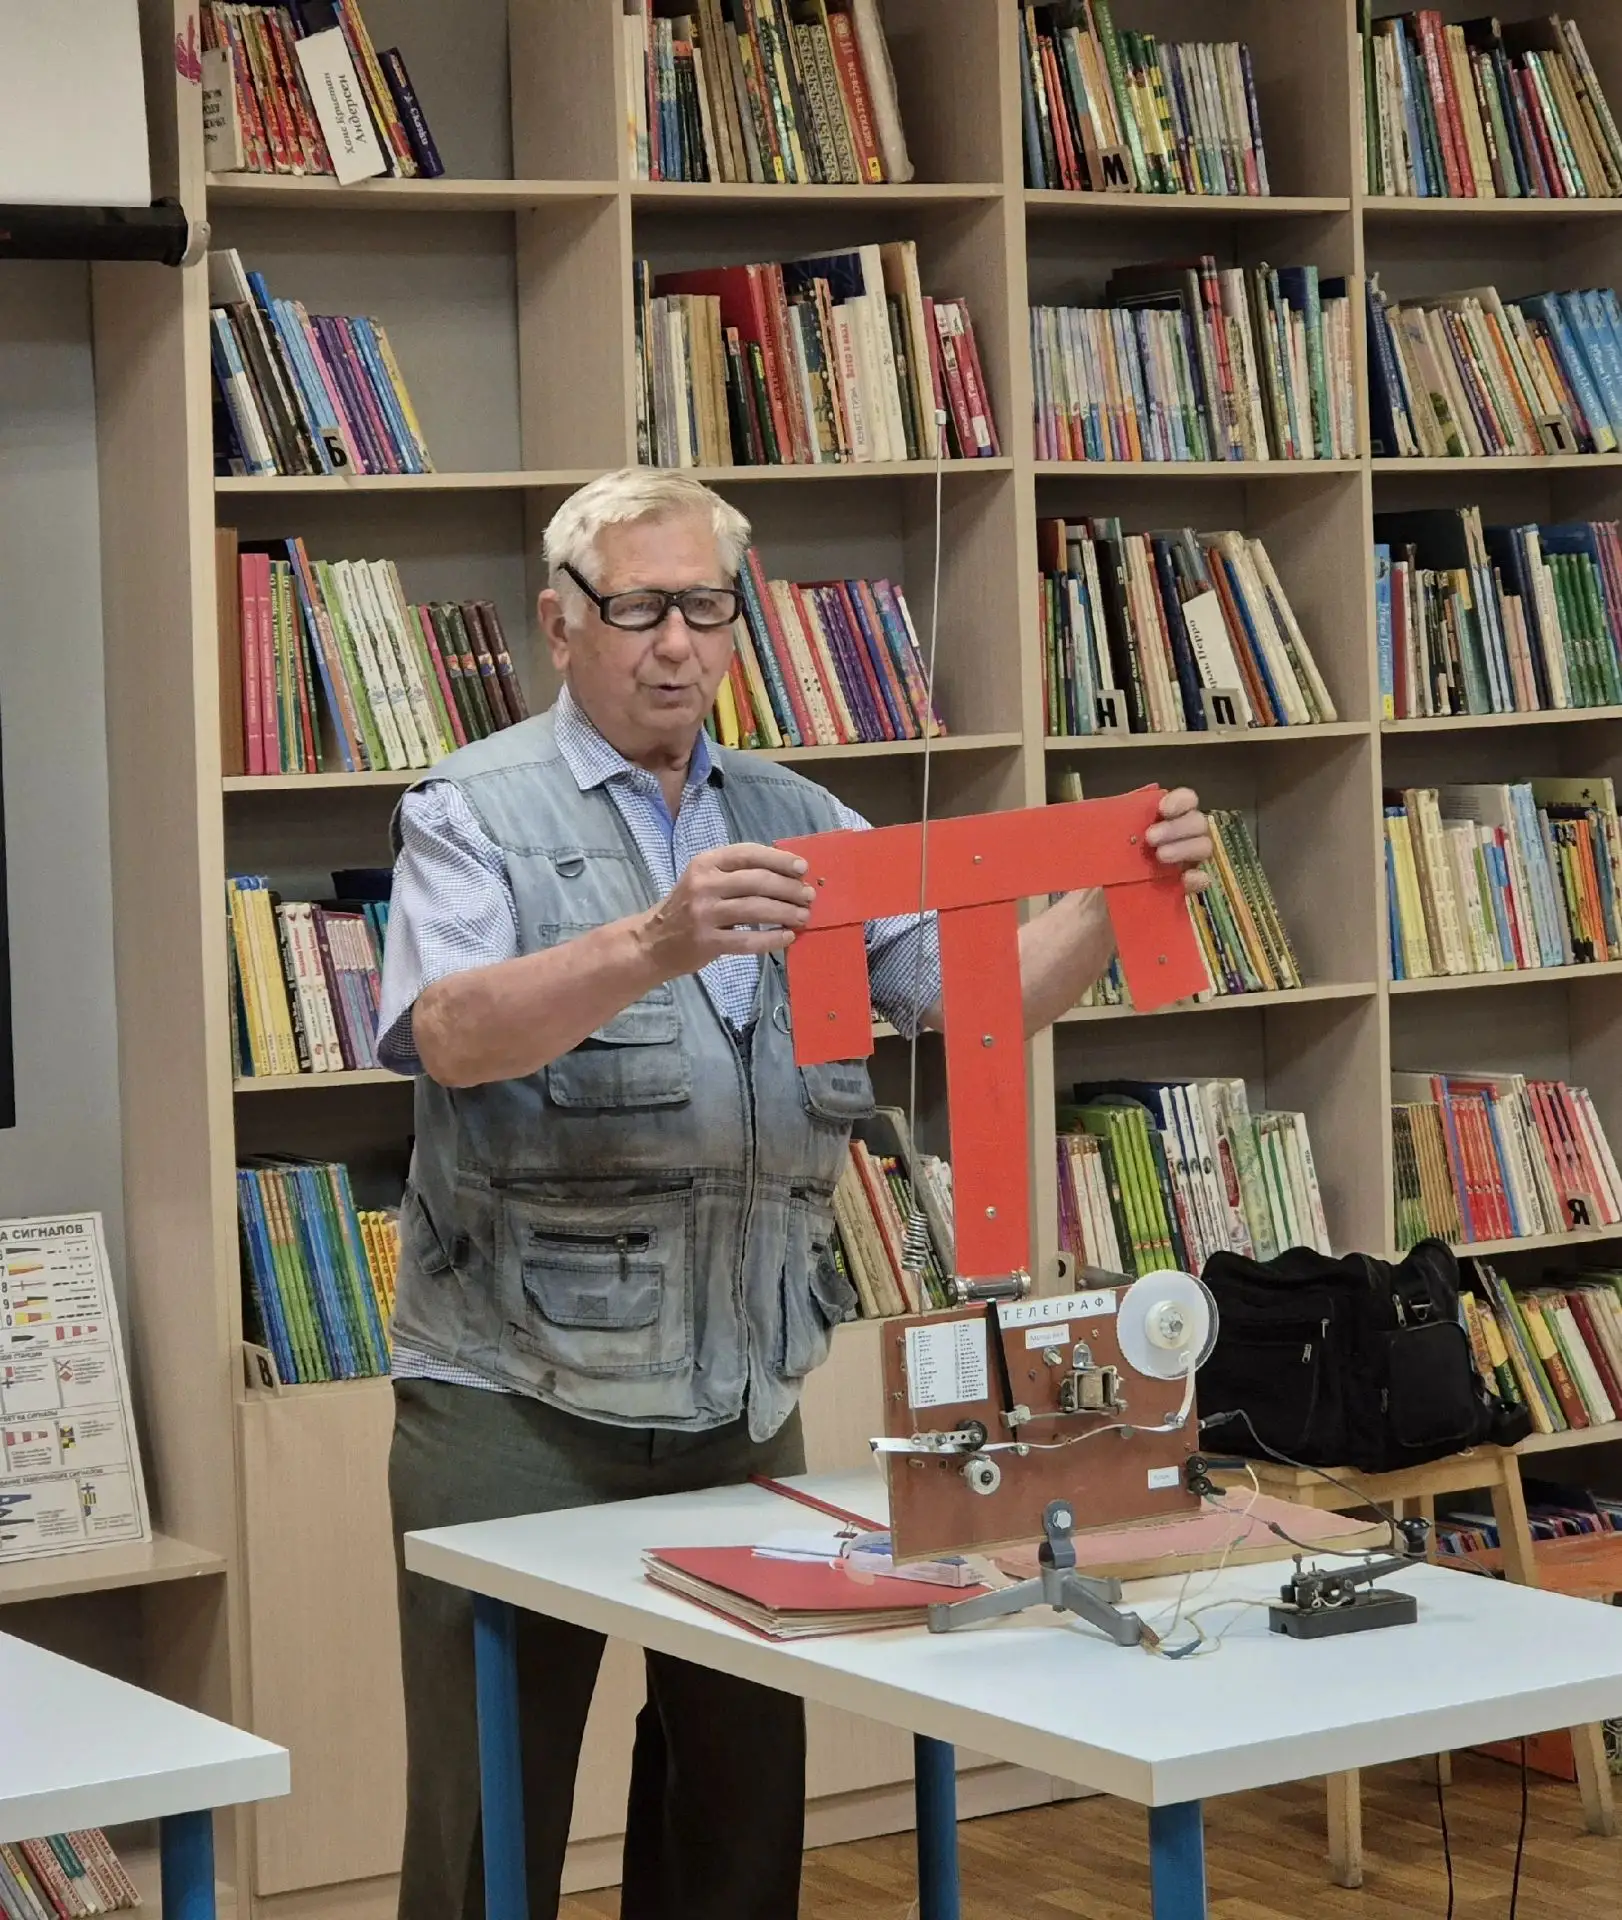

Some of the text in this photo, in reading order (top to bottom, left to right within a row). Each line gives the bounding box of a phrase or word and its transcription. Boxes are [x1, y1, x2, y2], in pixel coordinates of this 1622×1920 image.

[325, 73, 355, 154] Ханс Кристиан
[338, 75, 367, 145] Андерсен
[1102, 153, 1128, 185] М
[1545, 422, 1566, 450] Т
[324, 437, 347, 467] Б
[1189, 618, 1206, 660] Перро
[1567, 1198, 1590, 1225] Я
[12, 1224, 84, 1240] СИГНАЛОВ
[1, 1282, 8, 1293] 8
[3, 1299, 10, 1310] 9
[1003, 1297, 1104, 1320] ТЕЛЕГРАФ
